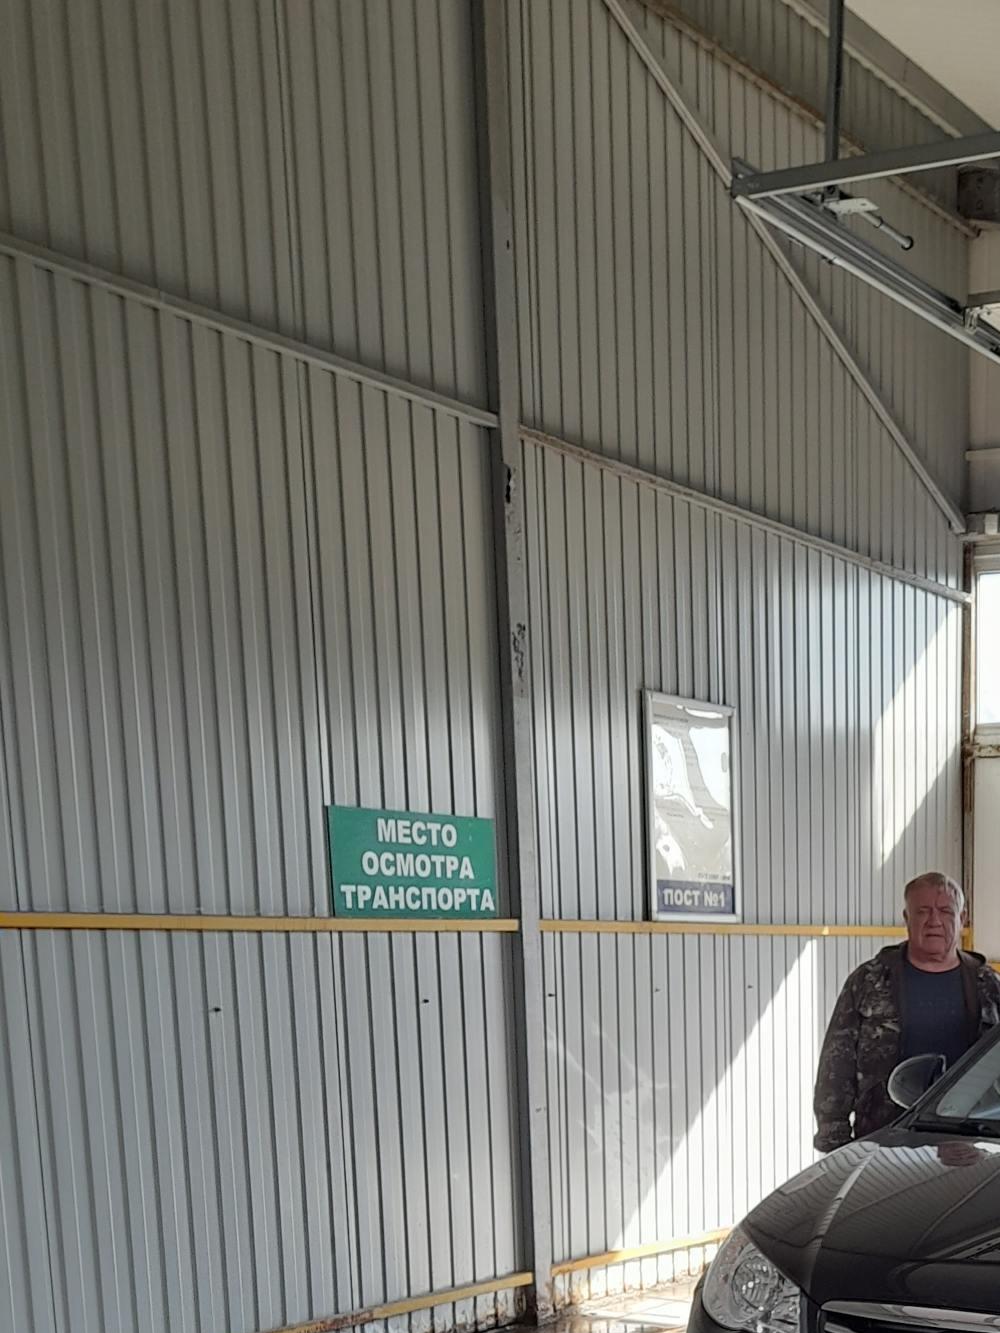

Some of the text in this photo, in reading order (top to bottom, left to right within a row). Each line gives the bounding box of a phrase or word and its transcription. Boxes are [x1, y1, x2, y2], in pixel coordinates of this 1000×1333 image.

[376, 818, 458, 848] МЕСТО
[361, 850, 475, 880] ОСМОТРА
[340, 884, 496, 912] ТРАНСПОРТА
[663, 887, 700, 907] ПОСТ
